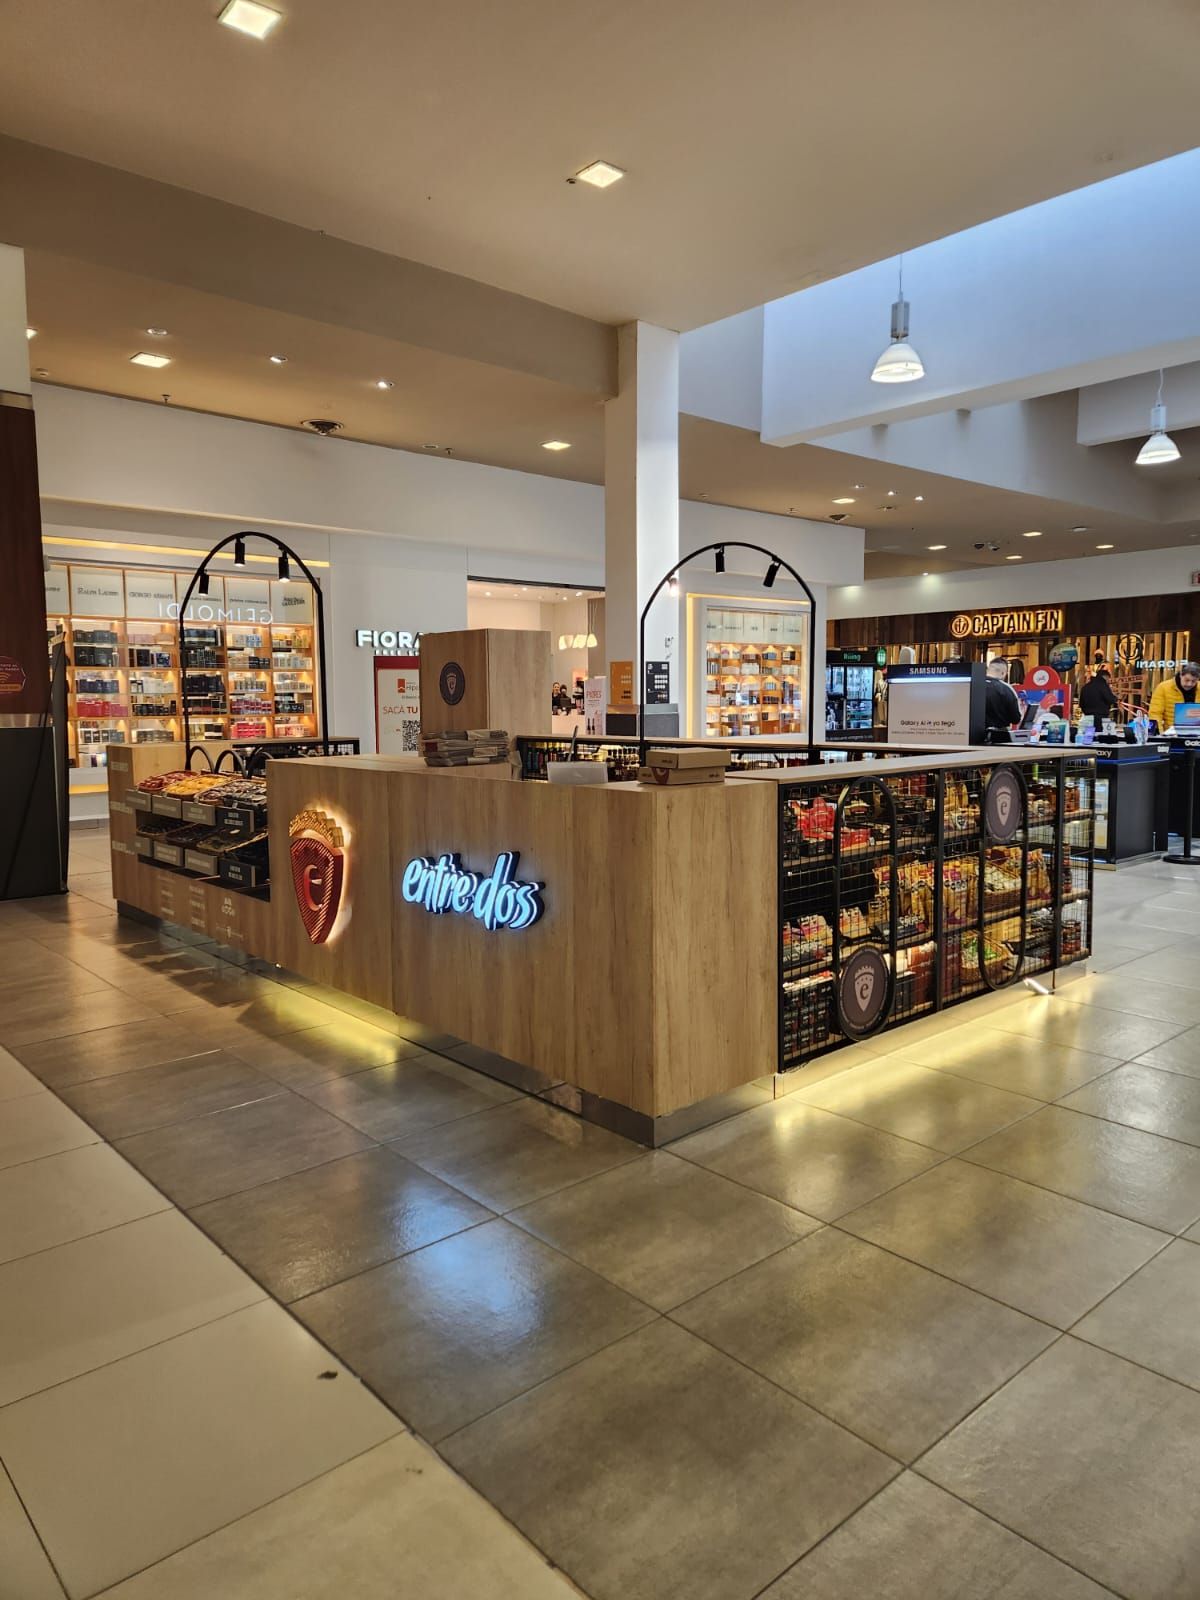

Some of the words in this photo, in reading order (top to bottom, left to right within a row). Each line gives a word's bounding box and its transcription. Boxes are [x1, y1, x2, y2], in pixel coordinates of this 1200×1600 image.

[972, 611, 1034, 636] CAPTAIN
[1034, 609, 1063, 633] FIN
[909, 667, 947, 675] SAMSUNG
